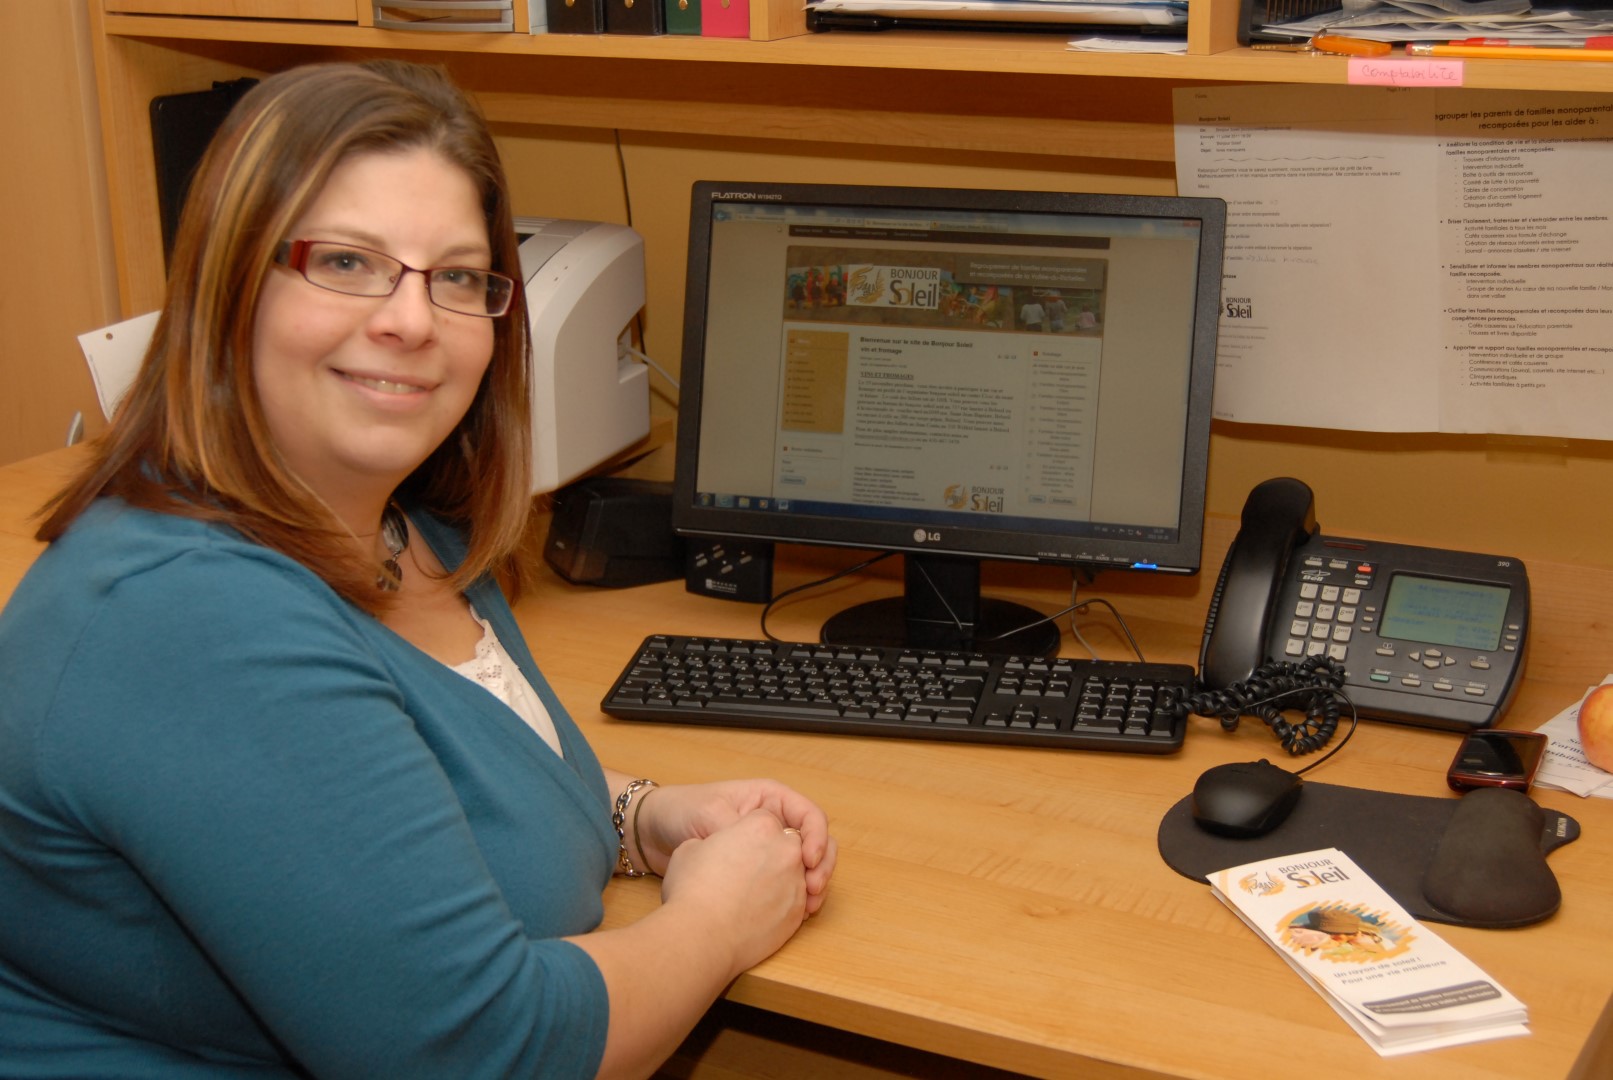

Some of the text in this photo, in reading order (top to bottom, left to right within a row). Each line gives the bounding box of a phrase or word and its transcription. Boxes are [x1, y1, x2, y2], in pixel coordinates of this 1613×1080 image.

[1470, 110, 1481, 118] les
[1483, 109, 1512, 119] parents
[1514, 108, 1524, 116] de
[1526, 107, 1555, 115] familles
[1478, 120, 1529, 131] recomposées
[1531, 121, 1549, 129] pour
[1564, 118, 1586, 126] aider
[1588, 117, 1594, 125] à
[891, 268, 937, 280] BONJOUR
[889, 280, 937, 307] Soleil
[1226, 304, 1252, 318] Soleil
[972, 486, 1004, 494] BONJOUR
[970, 494, 1004, 512] Soleil
[928, 533, 940, 541] LG
[1278, 859, 1333, 874] BONJOUR
[1286, 866, 1350, 889] Soleil
[1348, 967, 1376, 975] rayon
[1392, 958, 1416, 966] soleil
[1403, 961, 1447, 972] meilleure
